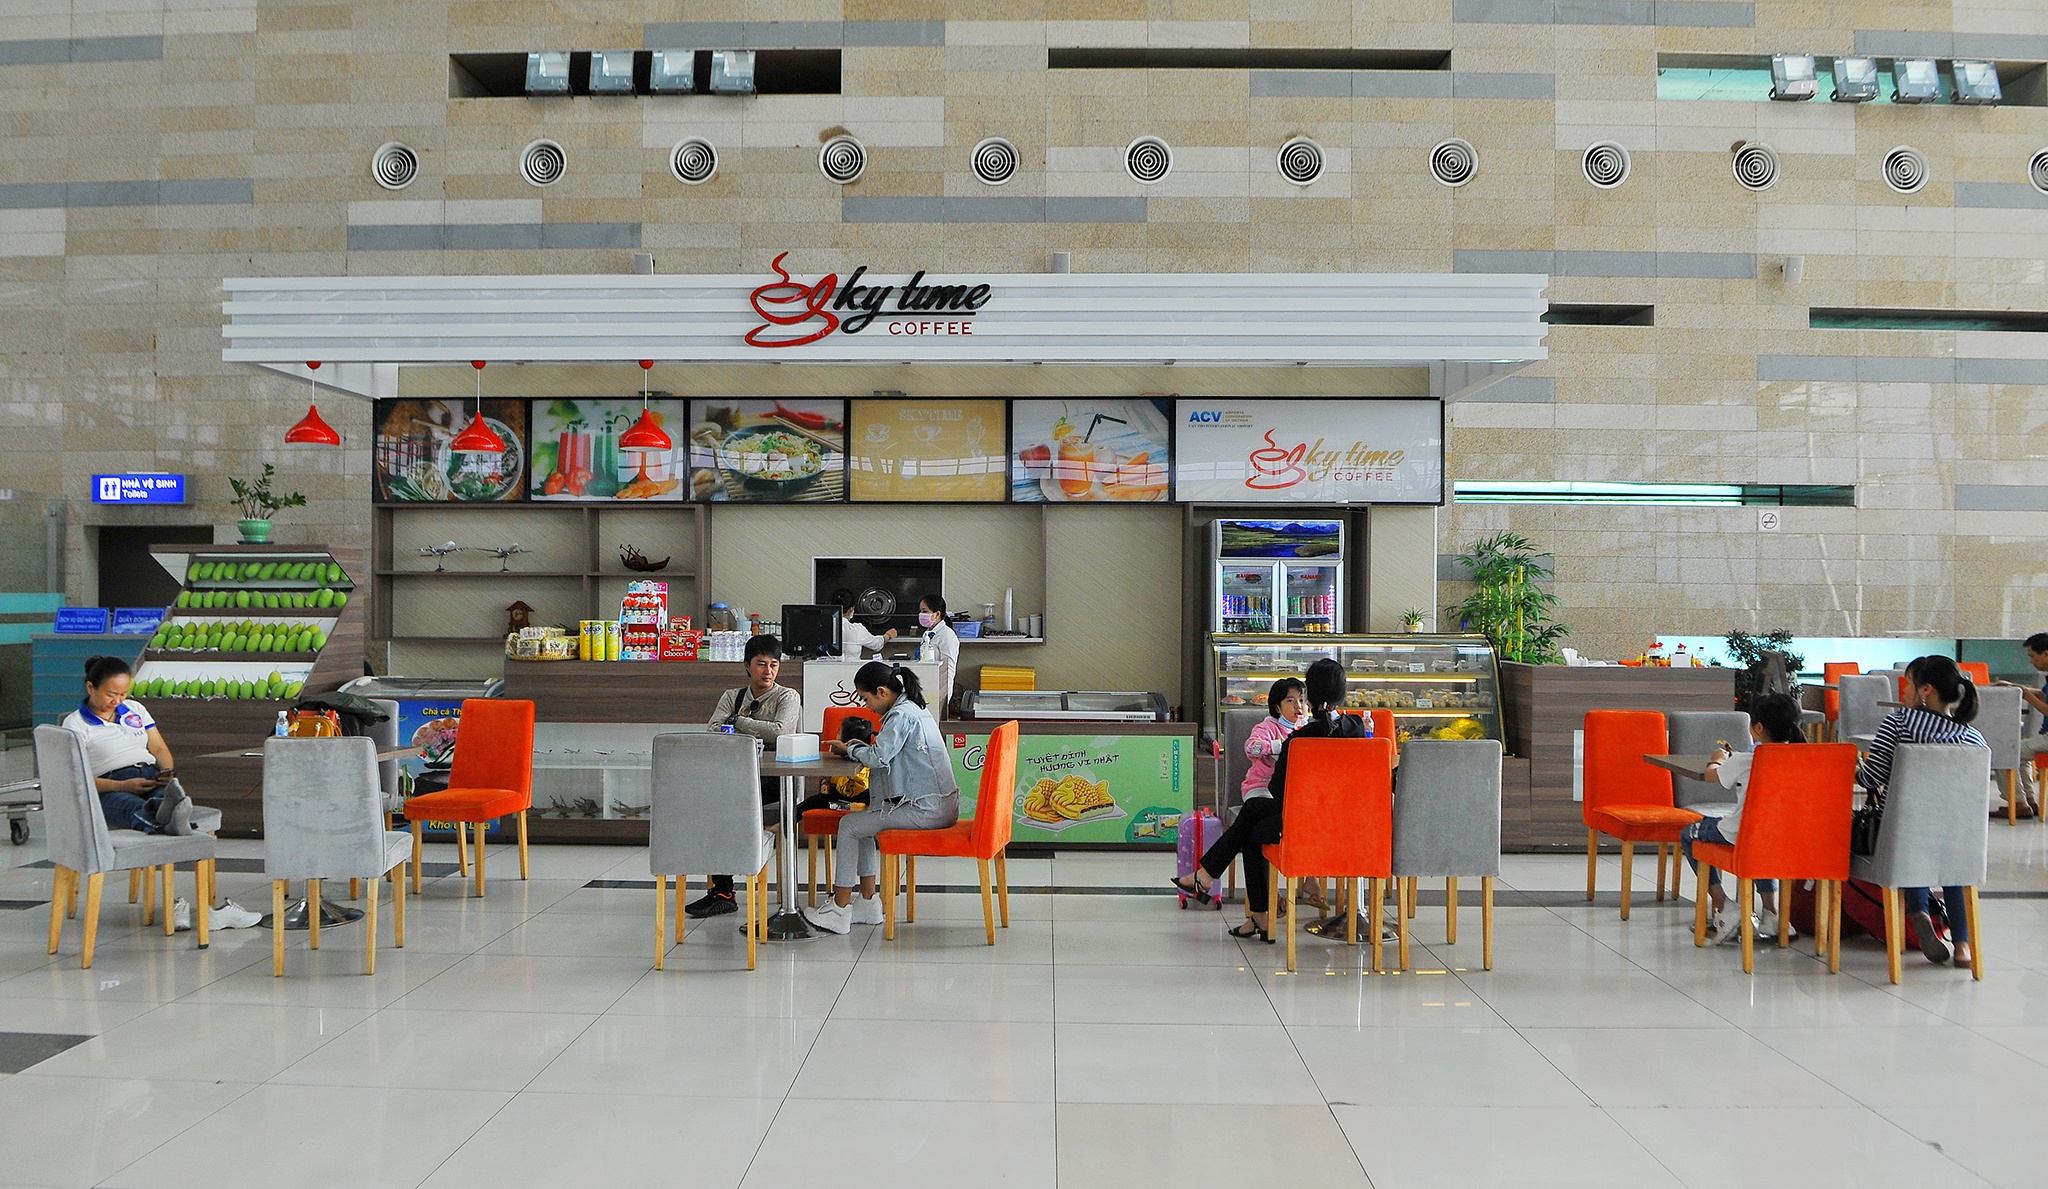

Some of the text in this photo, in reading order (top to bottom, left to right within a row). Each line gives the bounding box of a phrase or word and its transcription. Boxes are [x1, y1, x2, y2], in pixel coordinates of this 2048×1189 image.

[897, 270, 992, 311] time
[889, 322, 973, 335] COFFEE
[1189, 411, 1222, 423] ACV
[1346, 441, 1404, 467] time
[1334, 472, 1393, 481] COFFEE
[122, 477, 140, 488] NHÀ
[156, 479, 177, 489] SINH
[122, 489, 148, 499] Toilets
